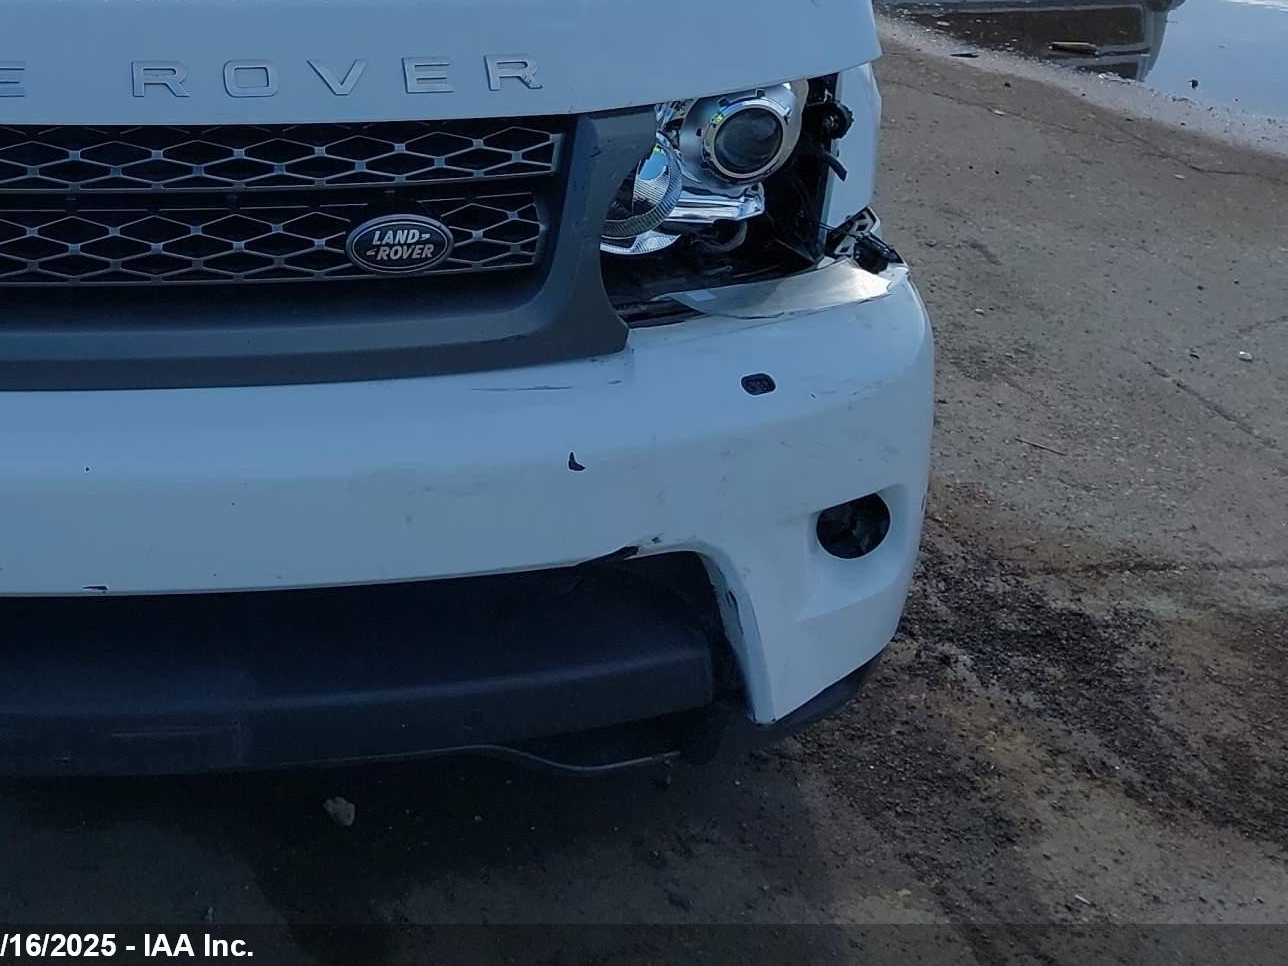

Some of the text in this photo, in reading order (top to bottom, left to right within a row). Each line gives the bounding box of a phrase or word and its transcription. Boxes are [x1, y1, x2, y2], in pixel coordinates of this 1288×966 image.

[130, 52, 544, 98] ROVER
[372, 229, 420, 245] LAND
[376, 244, 435, 261] ROVER
